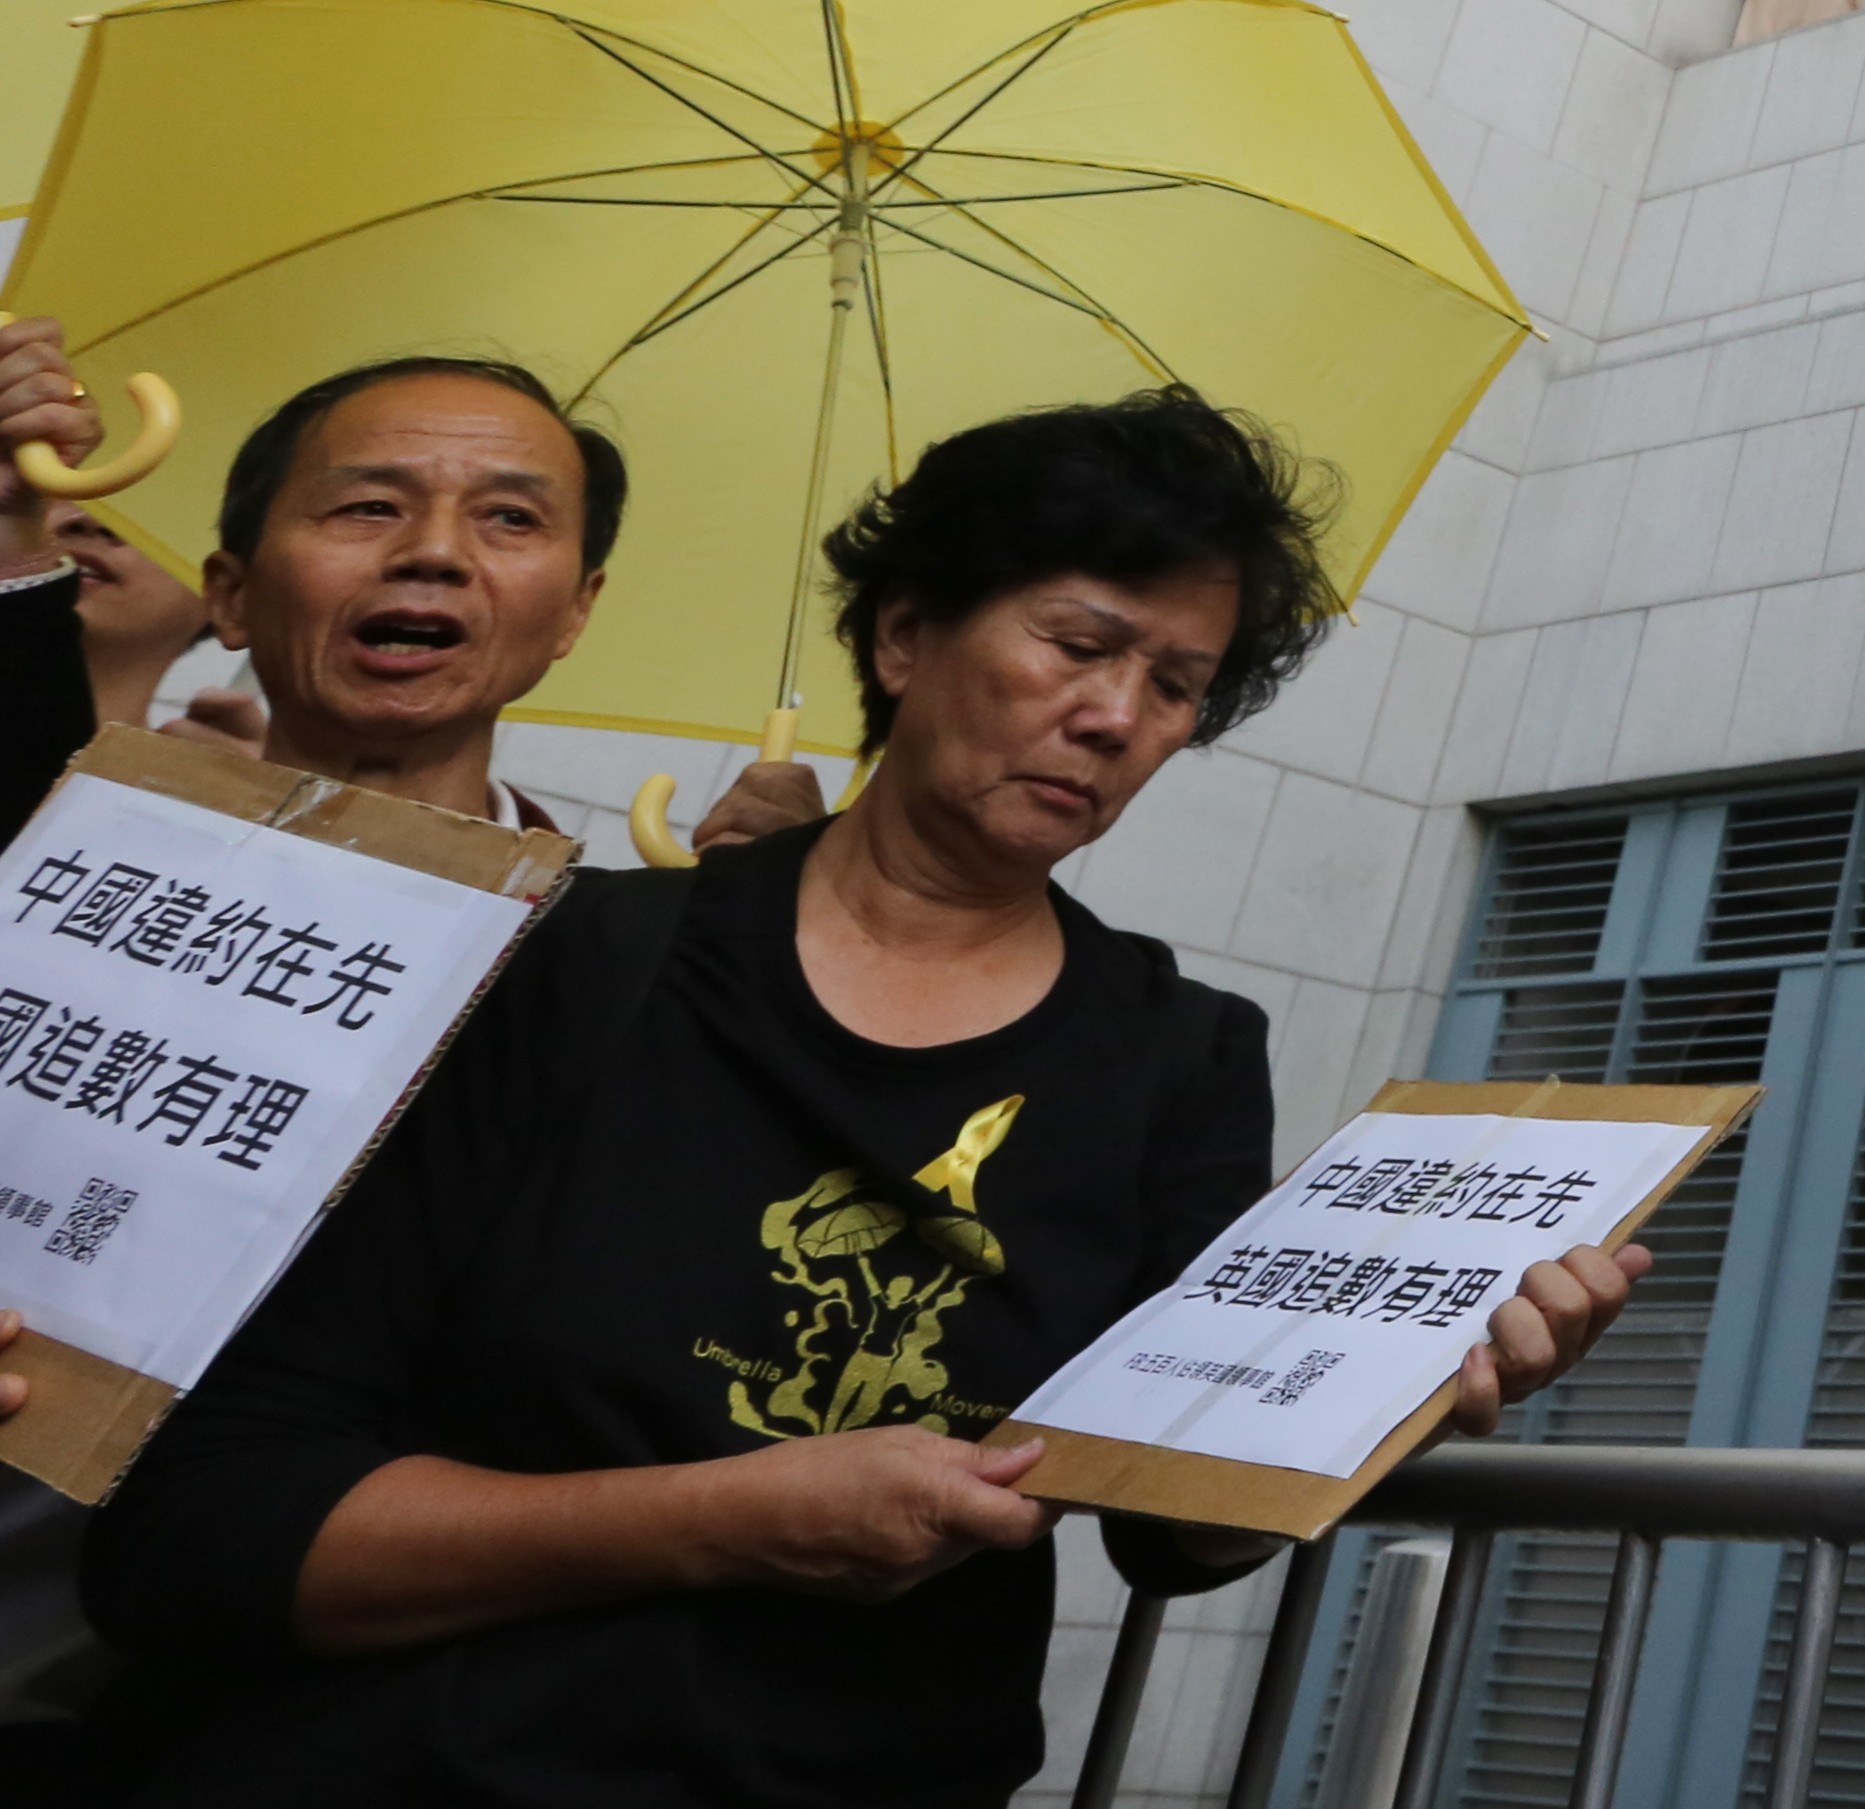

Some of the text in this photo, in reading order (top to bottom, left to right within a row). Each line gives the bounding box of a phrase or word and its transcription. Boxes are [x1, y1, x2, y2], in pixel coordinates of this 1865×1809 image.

[12, 849, 406, 1031] 中國違約在先
[1299, 1155, 1598, 1229] 中國違約在先
[1181, 1243, 1503, 1328] 英國追數有理
[693, 1336, 783, 1383] Umbrella
[929, 1392, 1010, 1420] Movem
